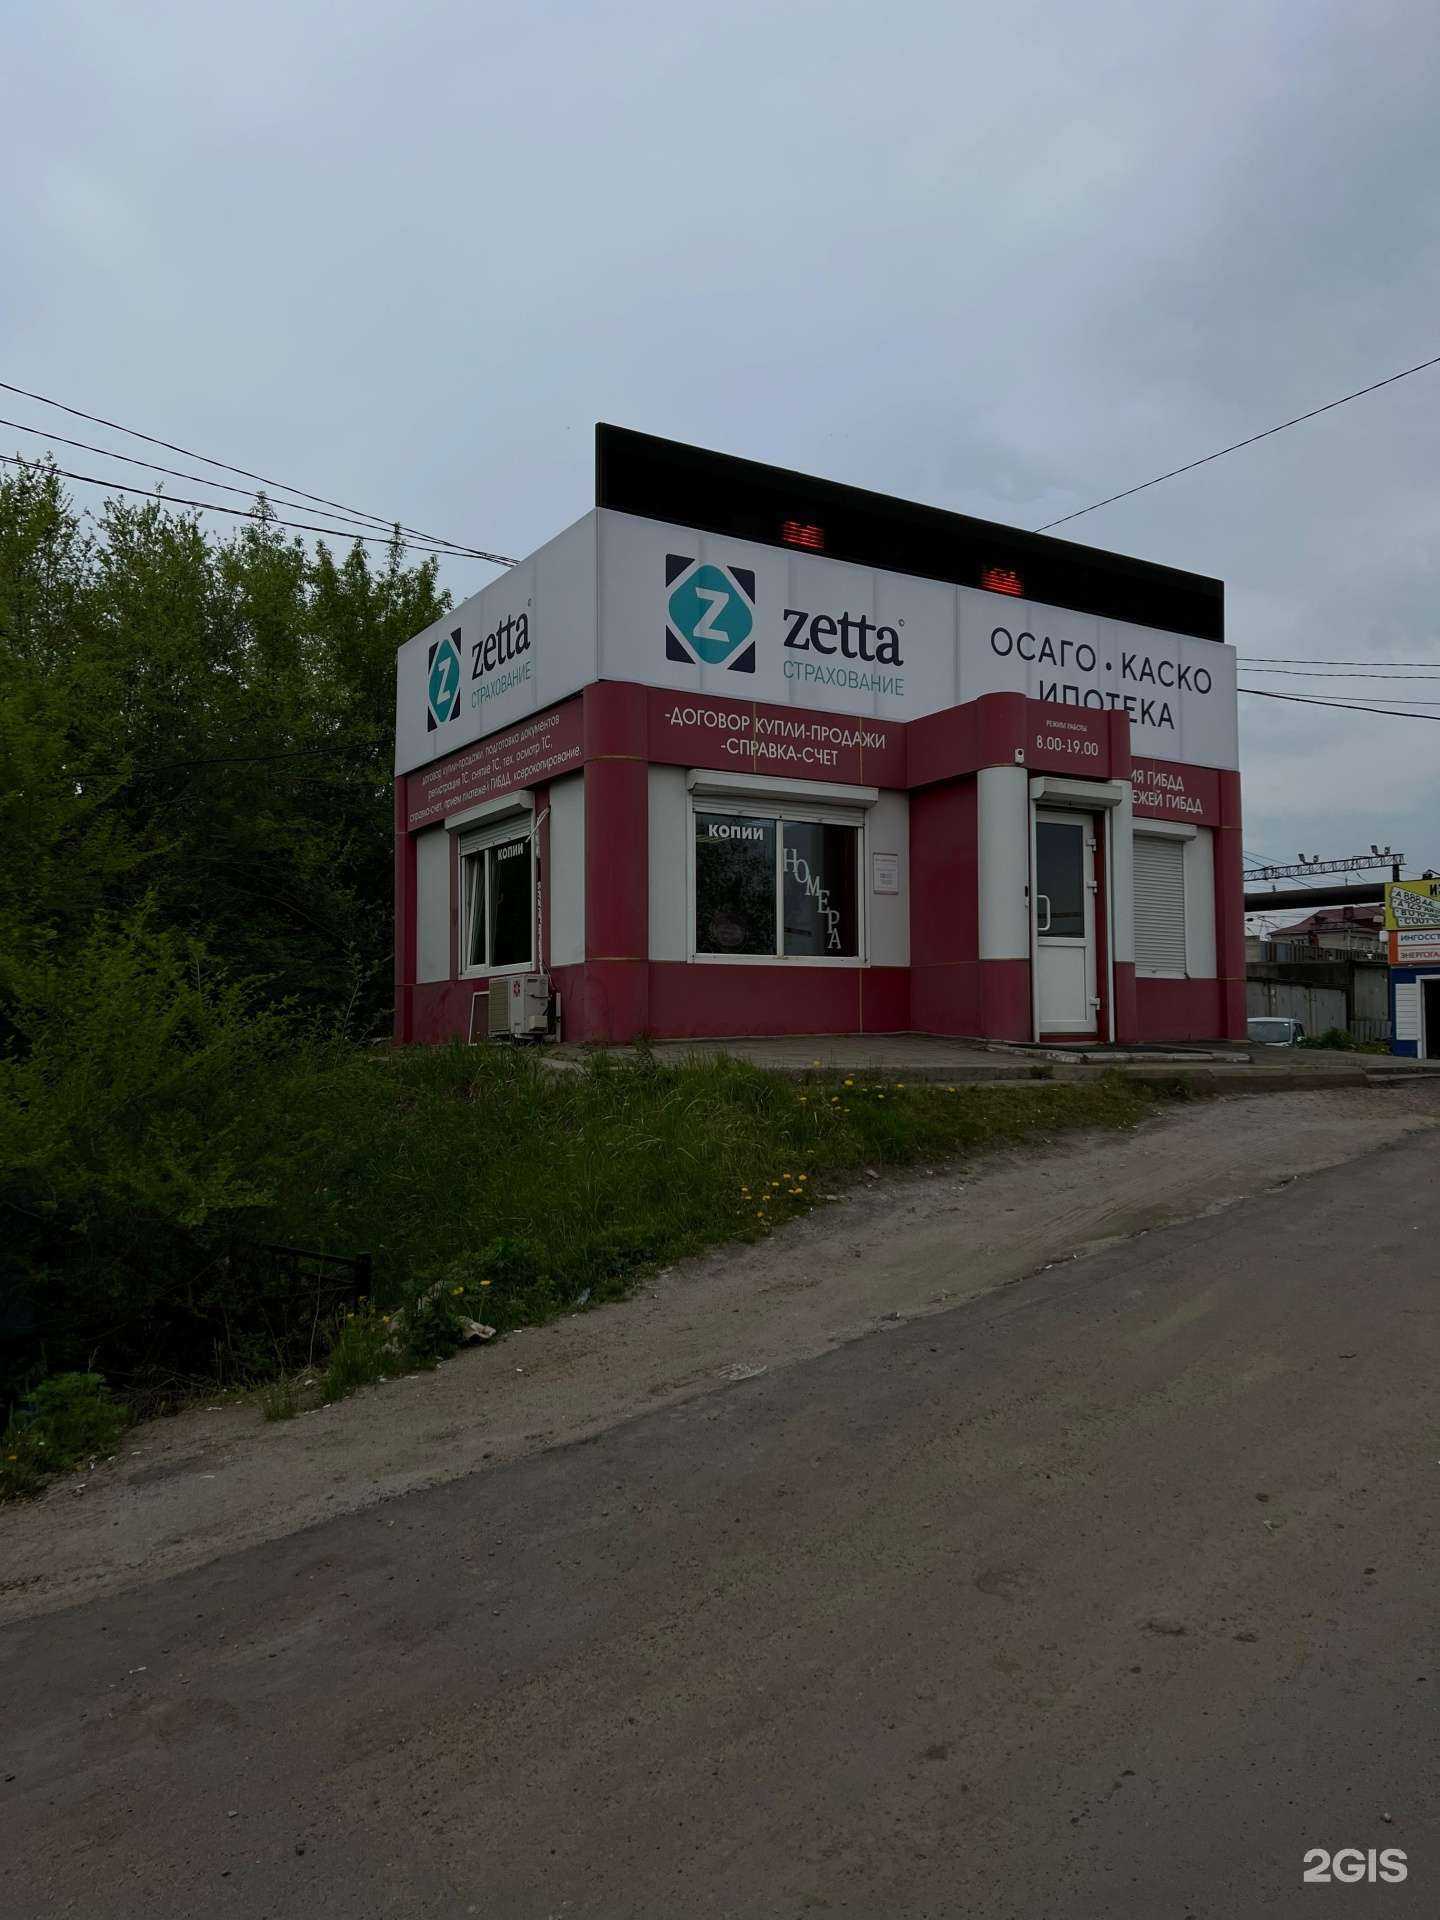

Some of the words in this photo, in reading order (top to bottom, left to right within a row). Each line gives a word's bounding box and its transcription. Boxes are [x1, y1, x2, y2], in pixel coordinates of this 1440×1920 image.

[471, 612, 531, 680] zetta
[783, 608, 904, 666] zetta
[990, 626, 1097, 672] ОСАГО
[1121, 651, 1213, 694] КАСКО
[471, 661, 531, 708] СТРАХОВАНИЕ
[783, 660, 904, 696] СТРАХОВАНИЕ
[1039, 679, 1175, 730] ИПОТЕКА
[755, 718, 887, 750] КУПЛИ-ПРОДАЖИ
[1036, 735, 1099, 756] 8.00-19.00
[1147, 771, 1185, 792] ГИБДД
[1166, 794, 1204, 815] ГИБДД
[783, 848, 842, 950] НОМЕРА
